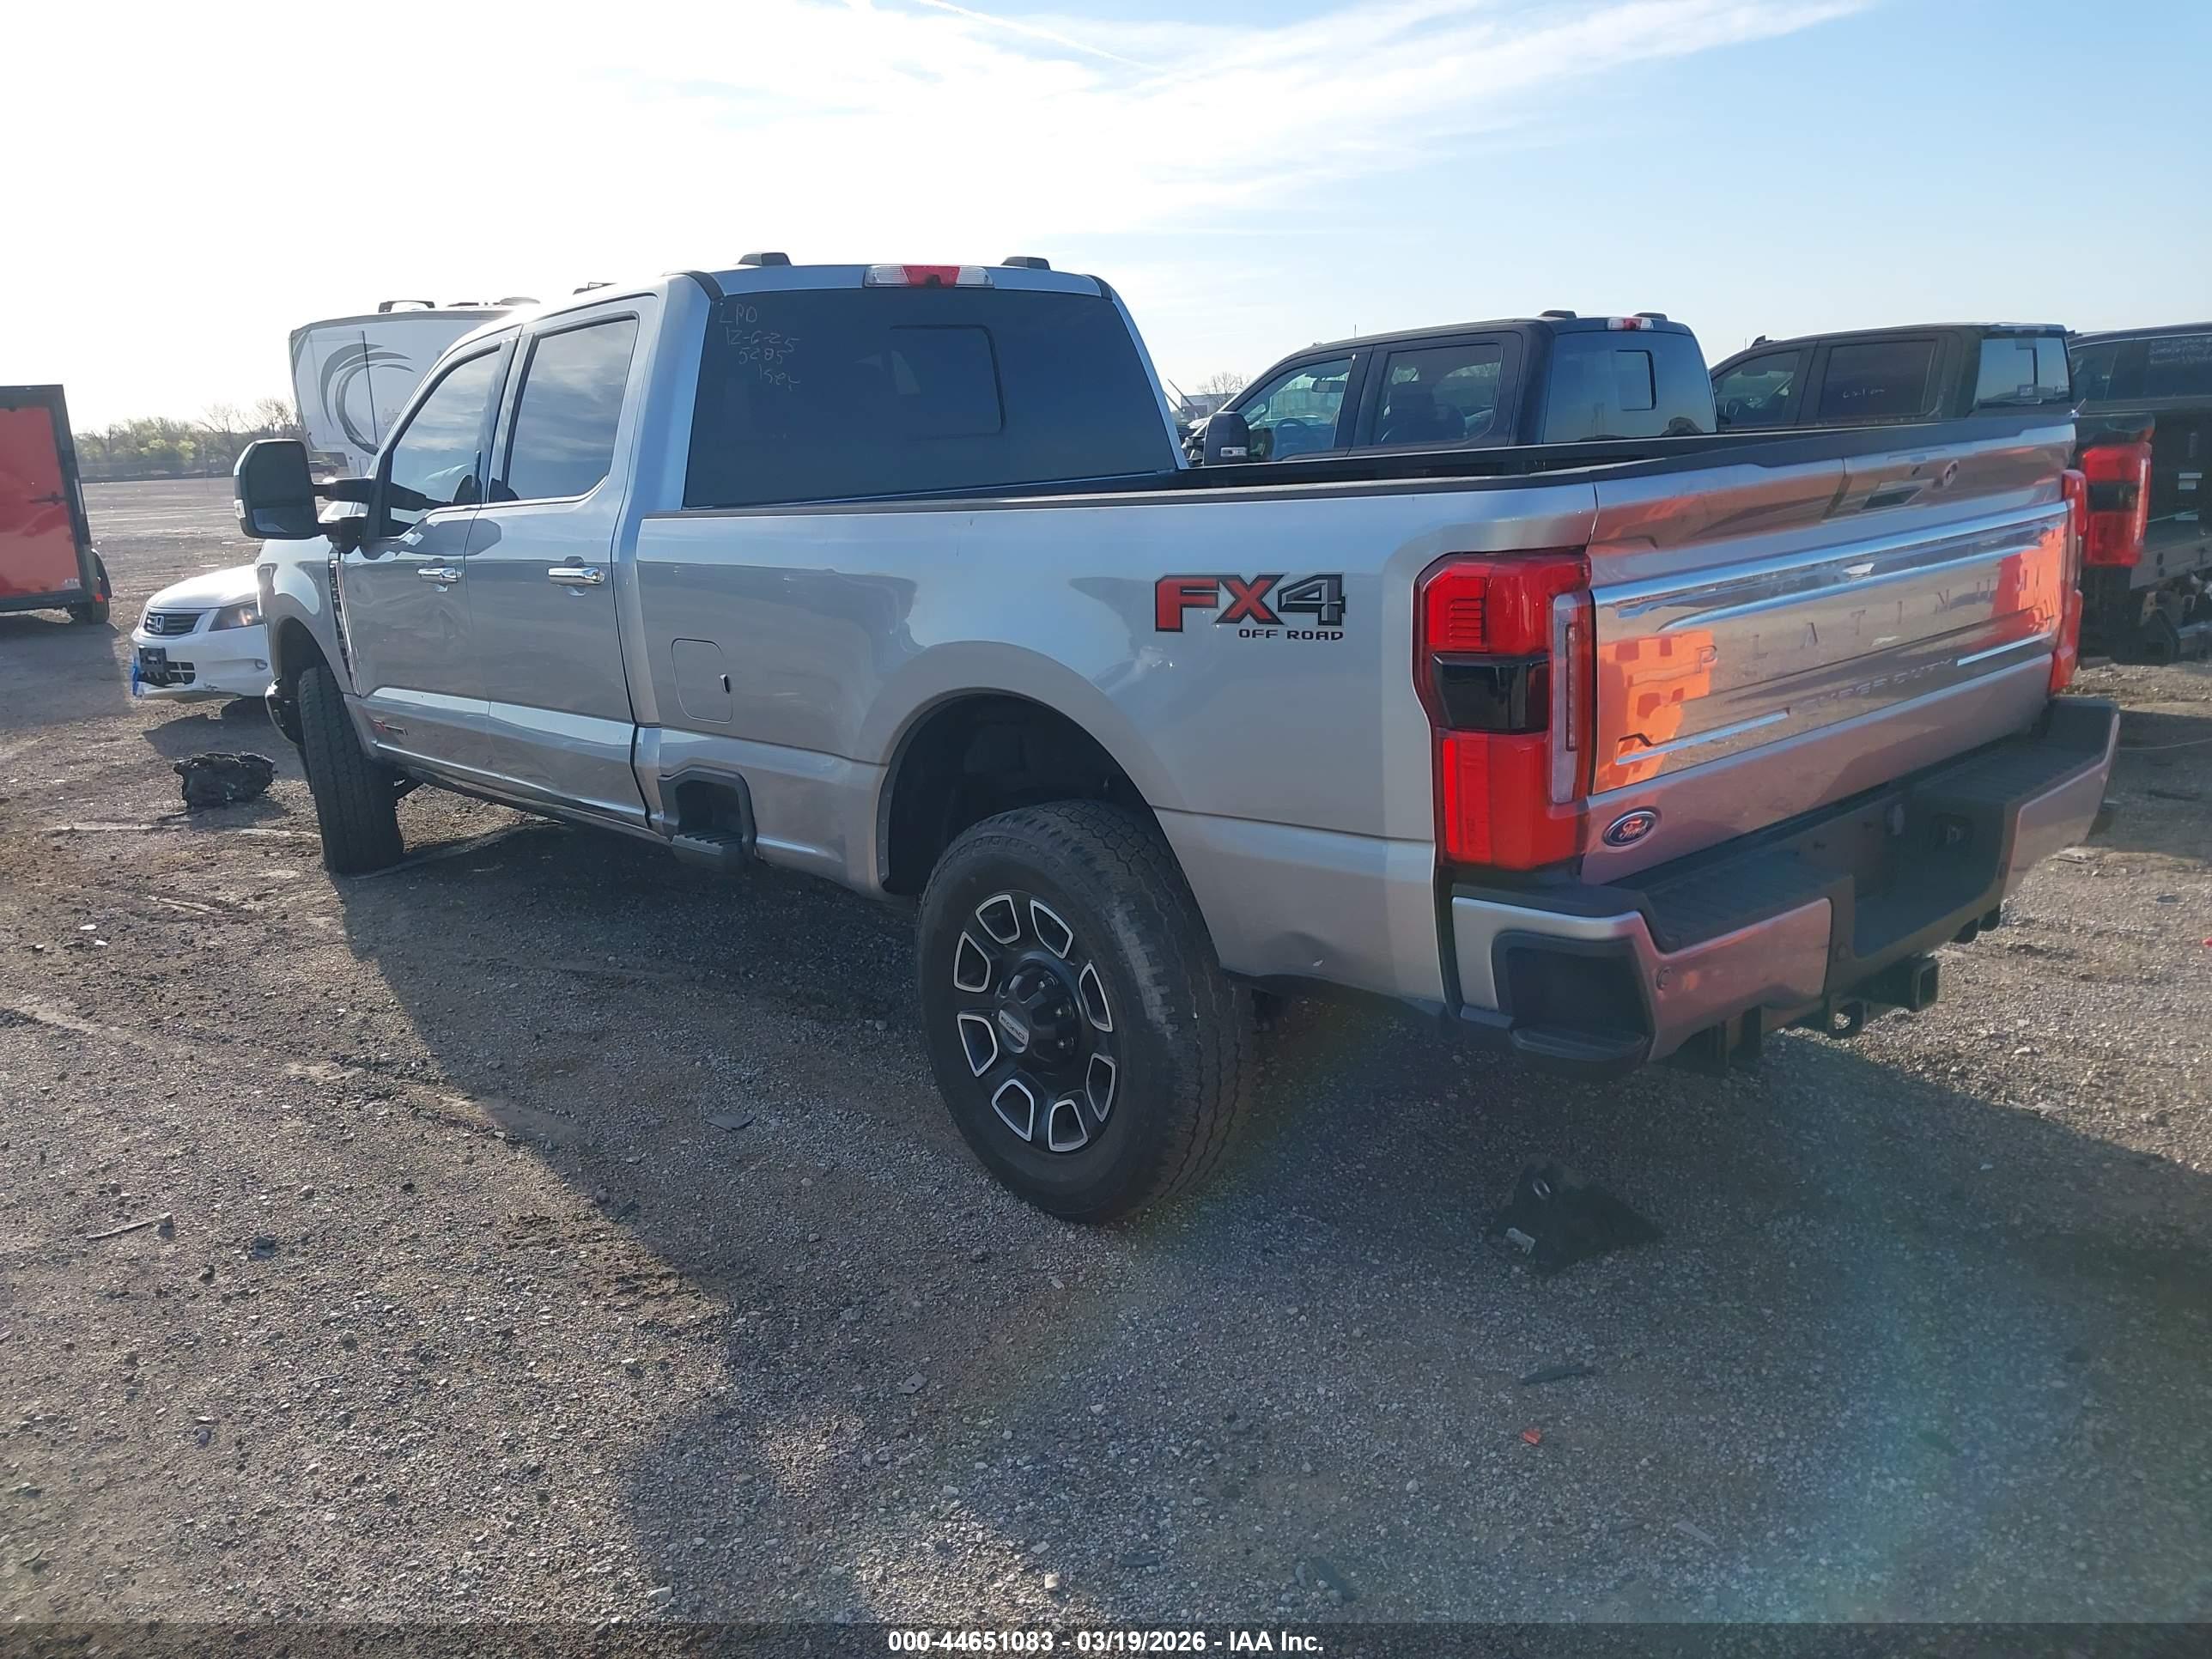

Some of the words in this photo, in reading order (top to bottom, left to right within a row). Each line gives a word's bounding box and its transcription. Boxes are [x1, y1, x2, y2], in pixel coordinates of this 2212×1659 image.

[1155, 574, 1346, 632] FX4
[1239, 629, 1278, 640] OFF
[1287, 629, 1343, 641] ROAD
[1619, 818, 1649, 840] Ford
[1000, 1016, 1025, 1040] FORD
